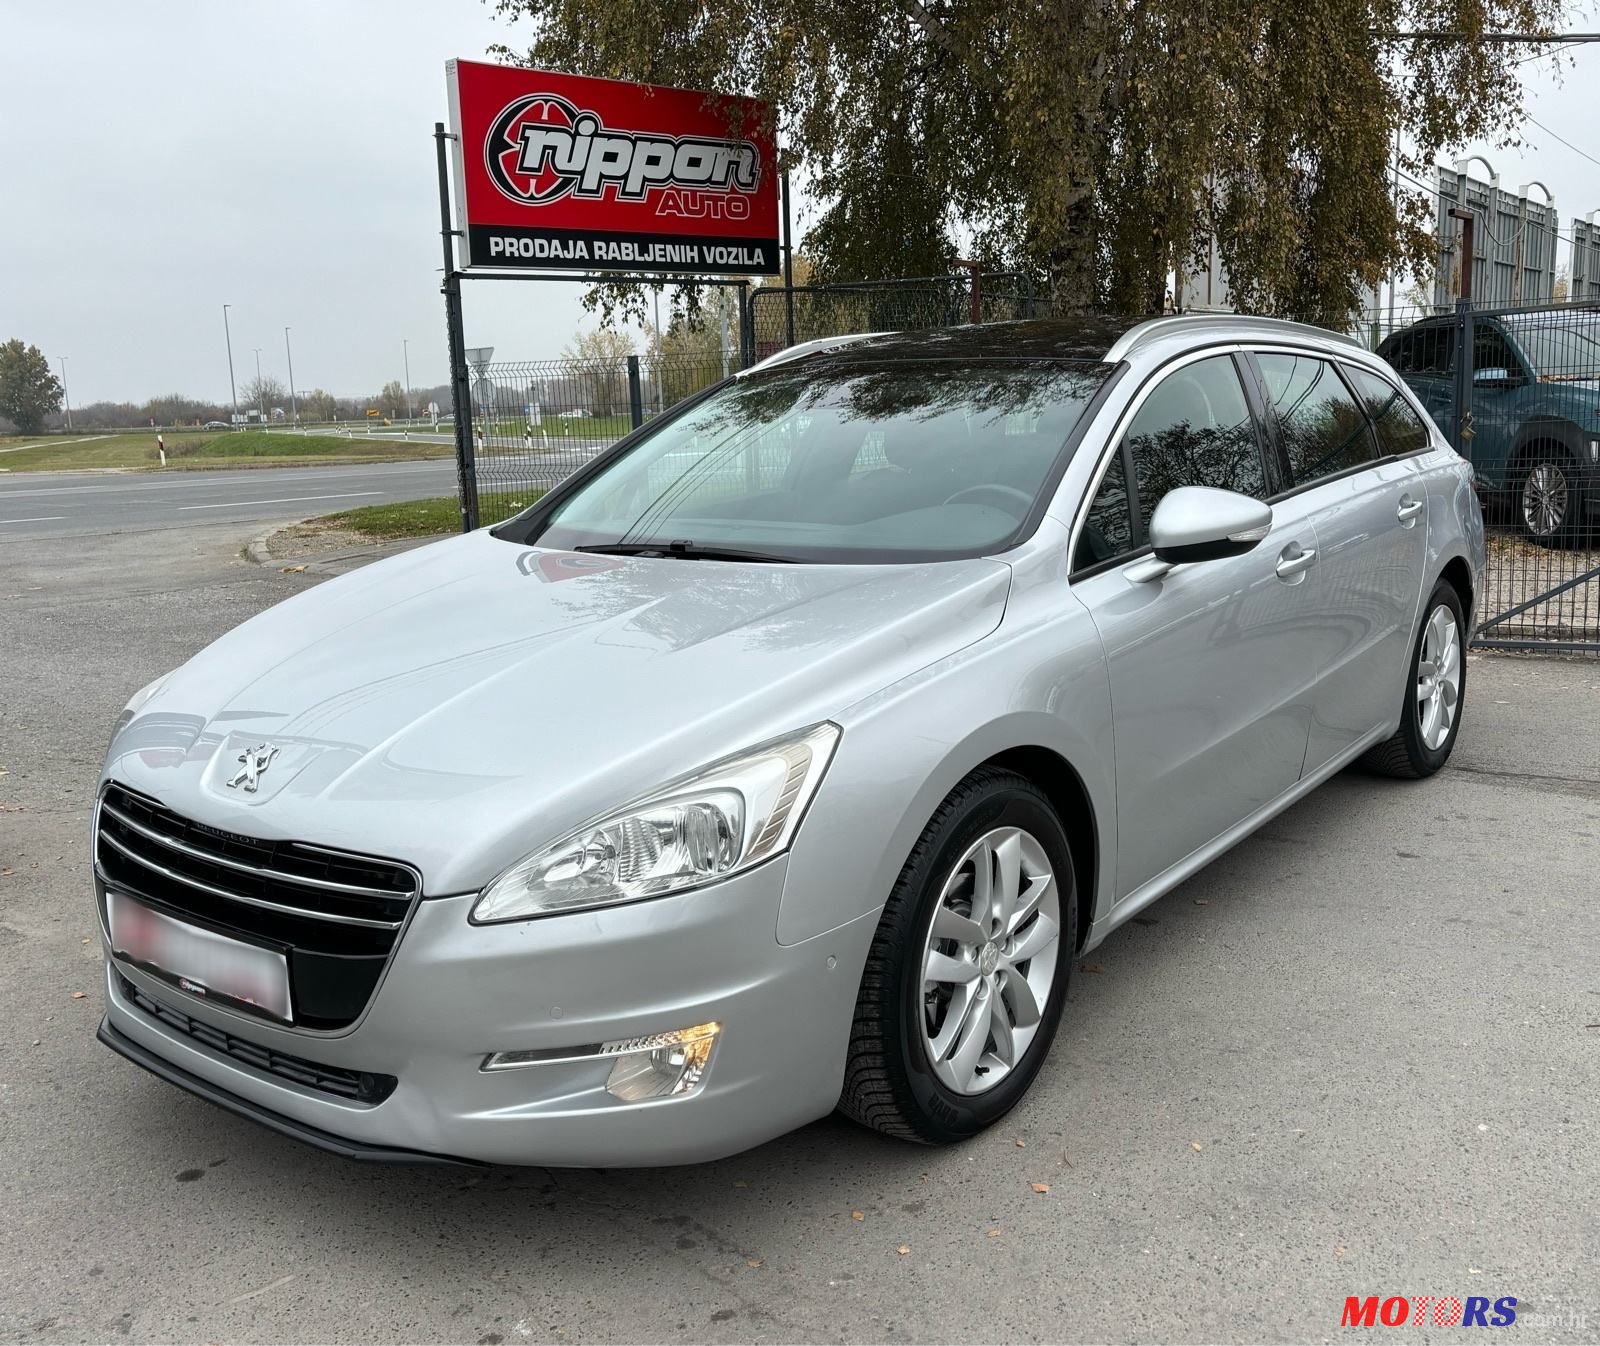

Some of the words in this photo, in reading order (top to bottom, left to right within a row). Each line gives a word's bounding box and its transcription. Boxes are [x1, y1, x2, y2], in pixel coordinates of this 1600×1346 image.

[520, 114, 757, 199] nippon
[656, 190, 750, 220] AUTO
[489, 236, 590, 260] PRODAJA
[593, 241, 699, 264] RABLJENIH
[703, 246, 766, 266] VOZILA
